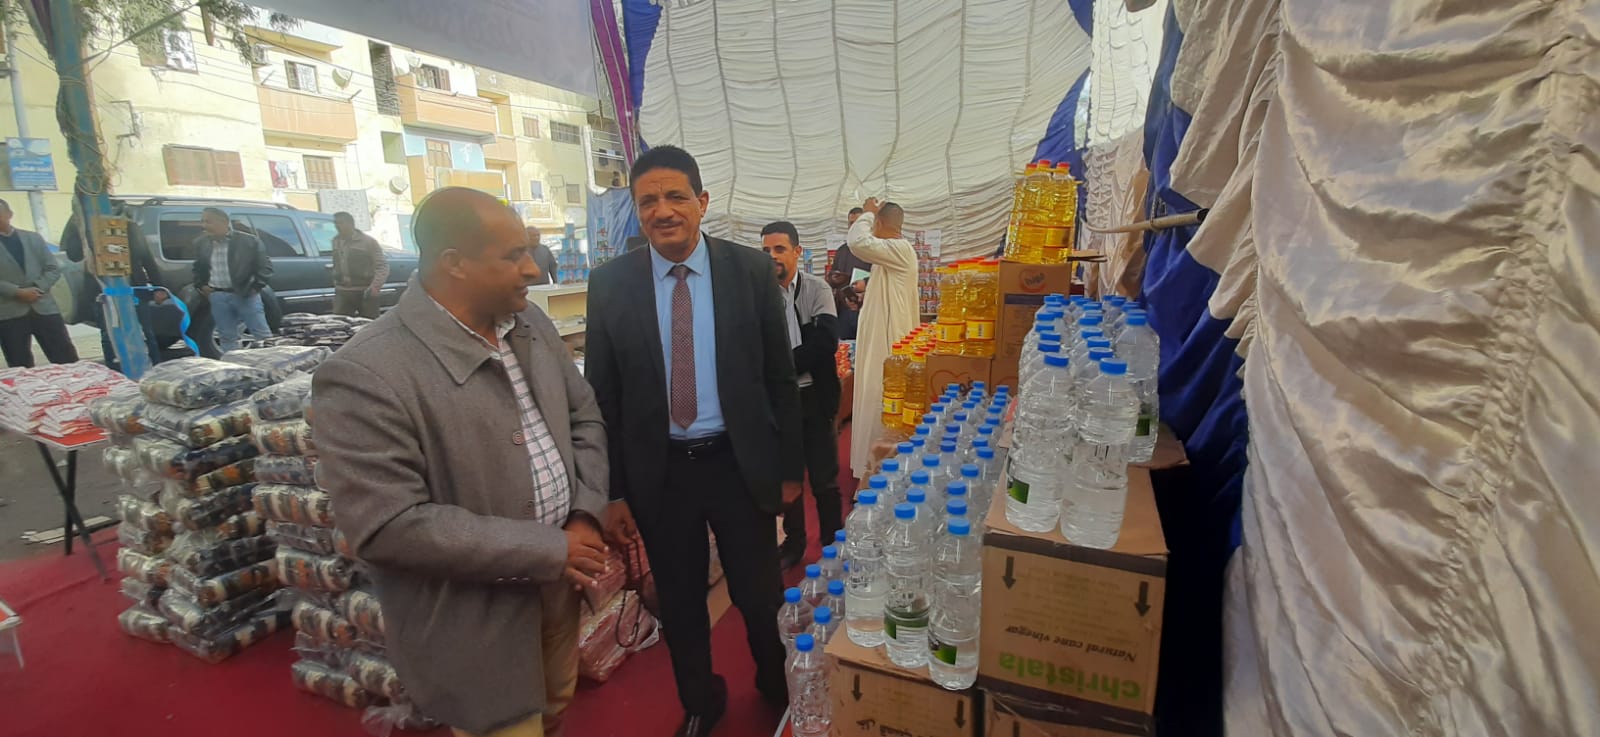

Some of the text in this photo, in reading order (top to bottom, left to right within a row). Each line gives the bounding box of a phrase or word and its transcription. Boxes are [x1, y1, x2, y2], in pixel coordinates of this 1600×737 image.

[1005, 624, 1137, 662] Natural cane vinegar
[998, 652, 1141, 700] christala
